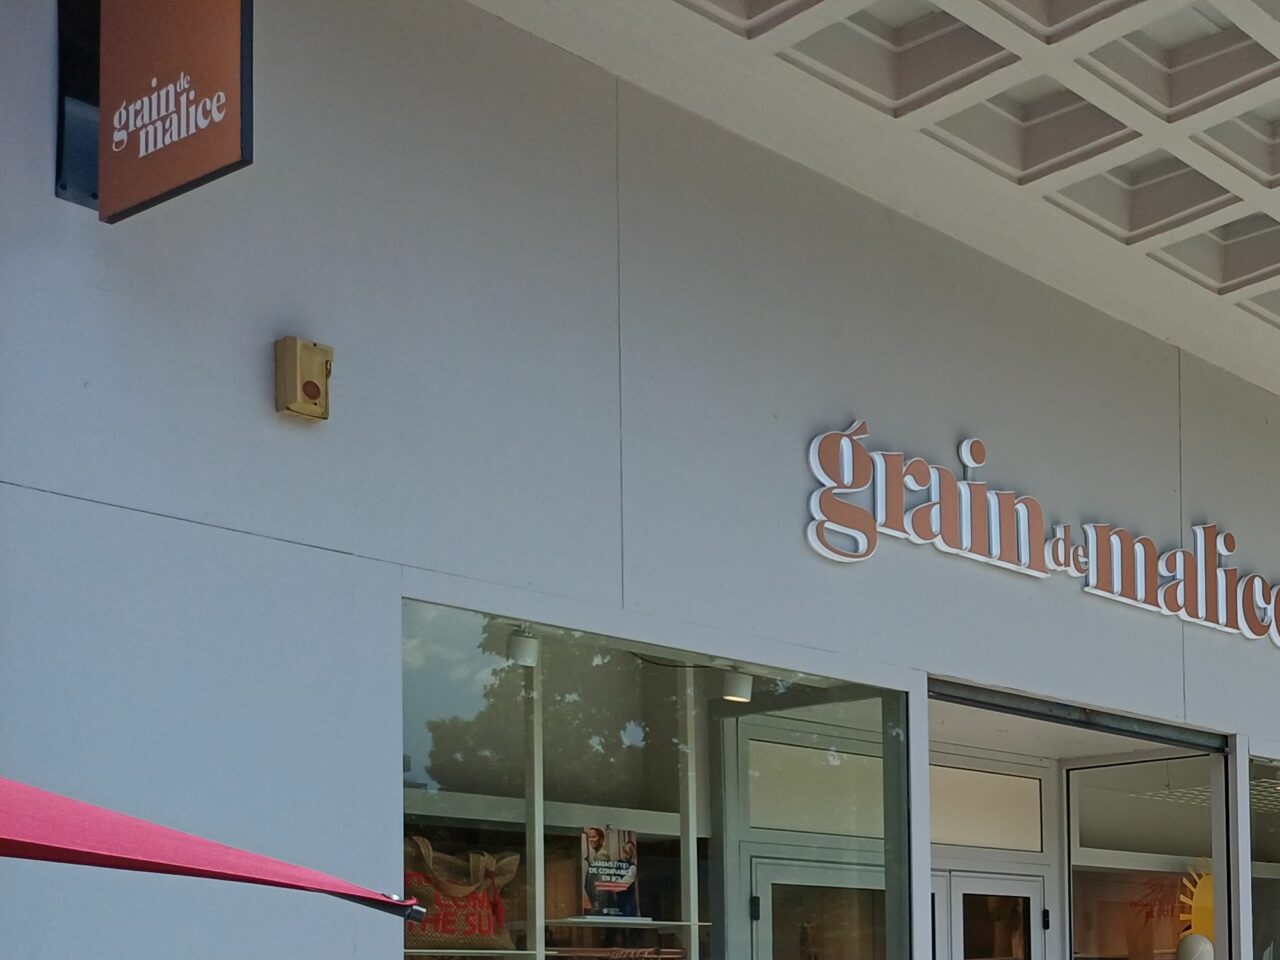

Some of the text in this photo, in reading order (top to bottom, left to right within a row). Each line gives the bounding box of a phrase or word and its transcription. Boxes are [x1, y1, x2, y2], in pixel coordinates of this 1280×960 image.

[112, 71, 191, 152] grain de
[139, 90, 227, 158] malice
[807, 418, 1051, 578] grain
[1045, 523, 1090, 578] de
